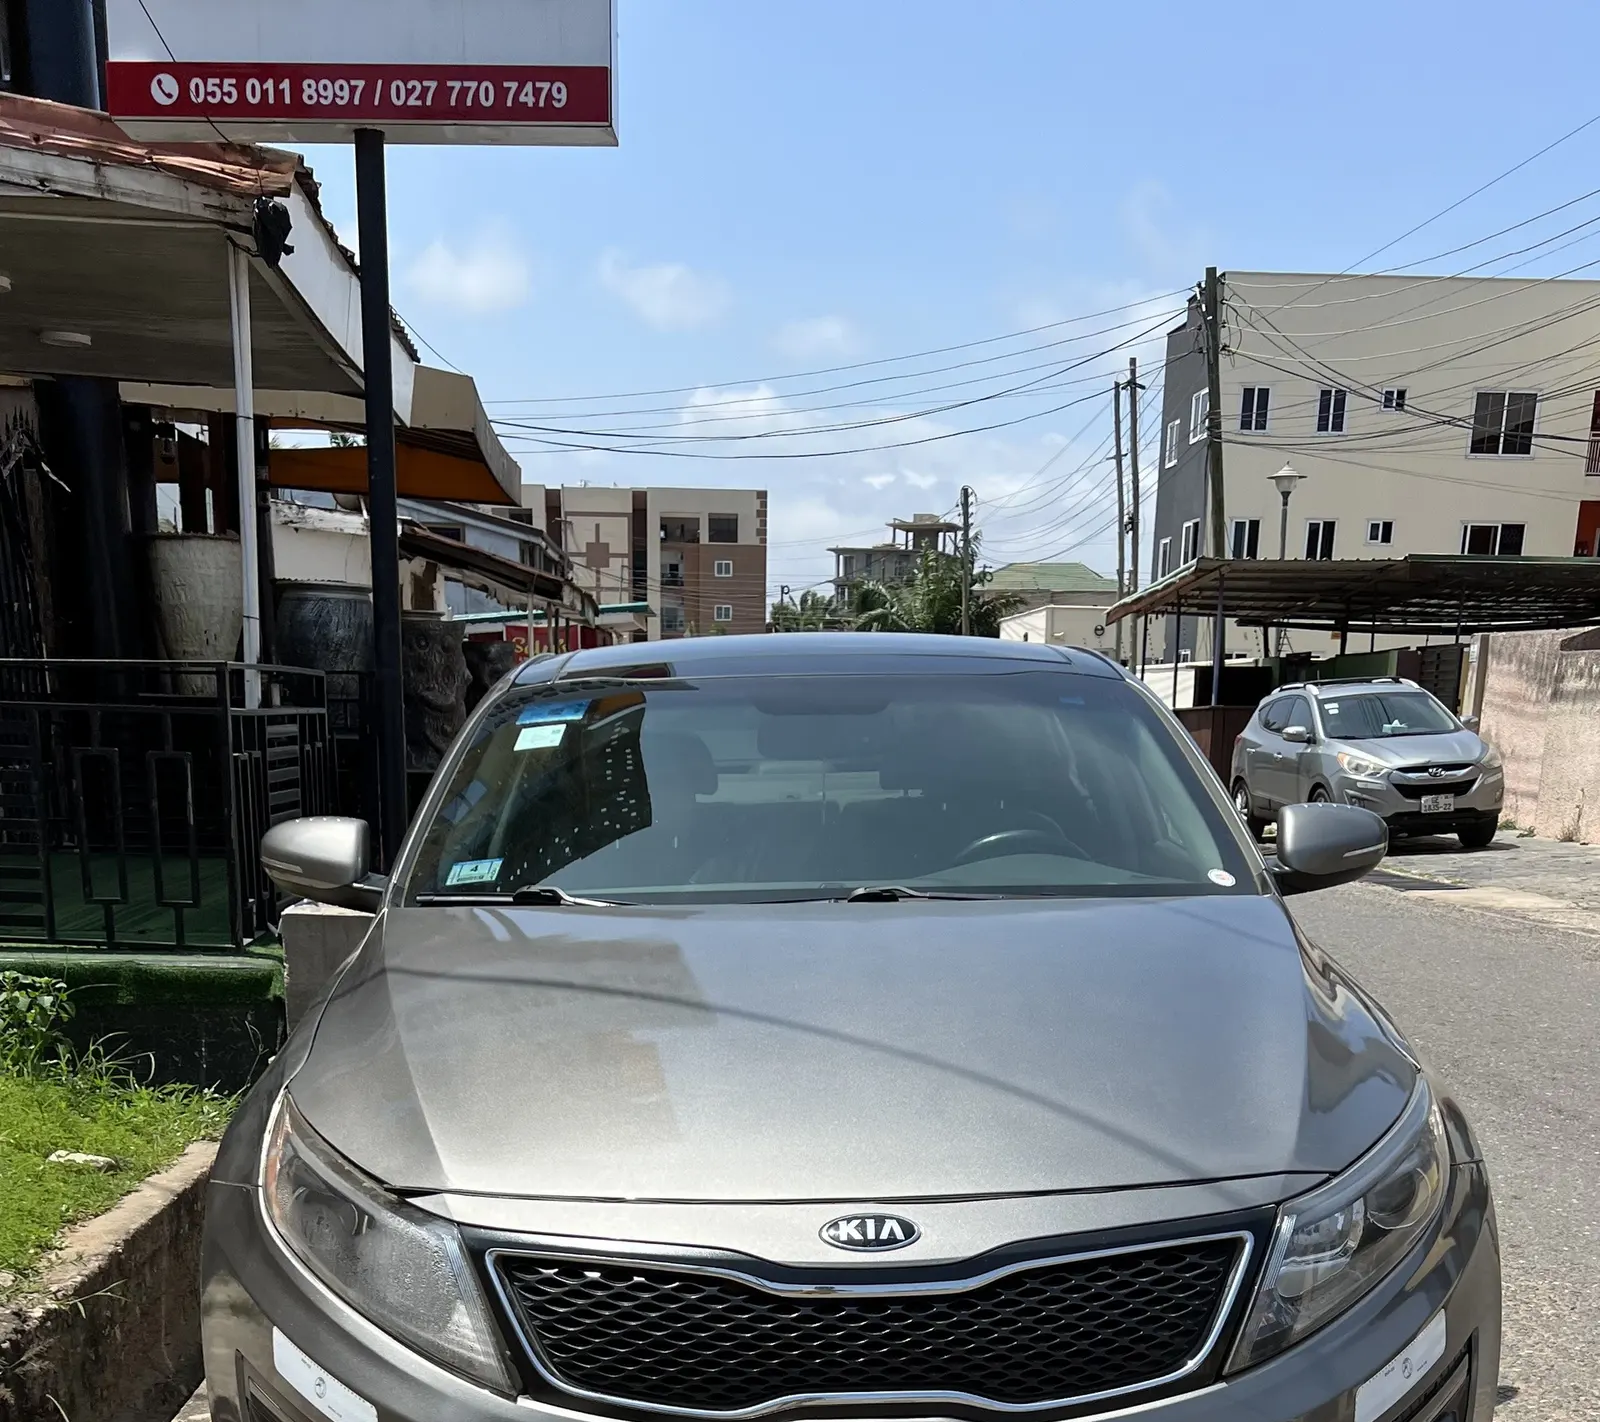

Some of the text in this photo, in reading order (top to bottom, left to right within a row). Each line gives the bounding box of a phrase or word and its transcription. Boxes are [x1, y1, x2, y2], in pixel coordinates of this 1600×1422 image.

[189, 77, 567, 109] 055 011 8997 / 027 770 7479
[837, 1218, 906, 1241] KIA
